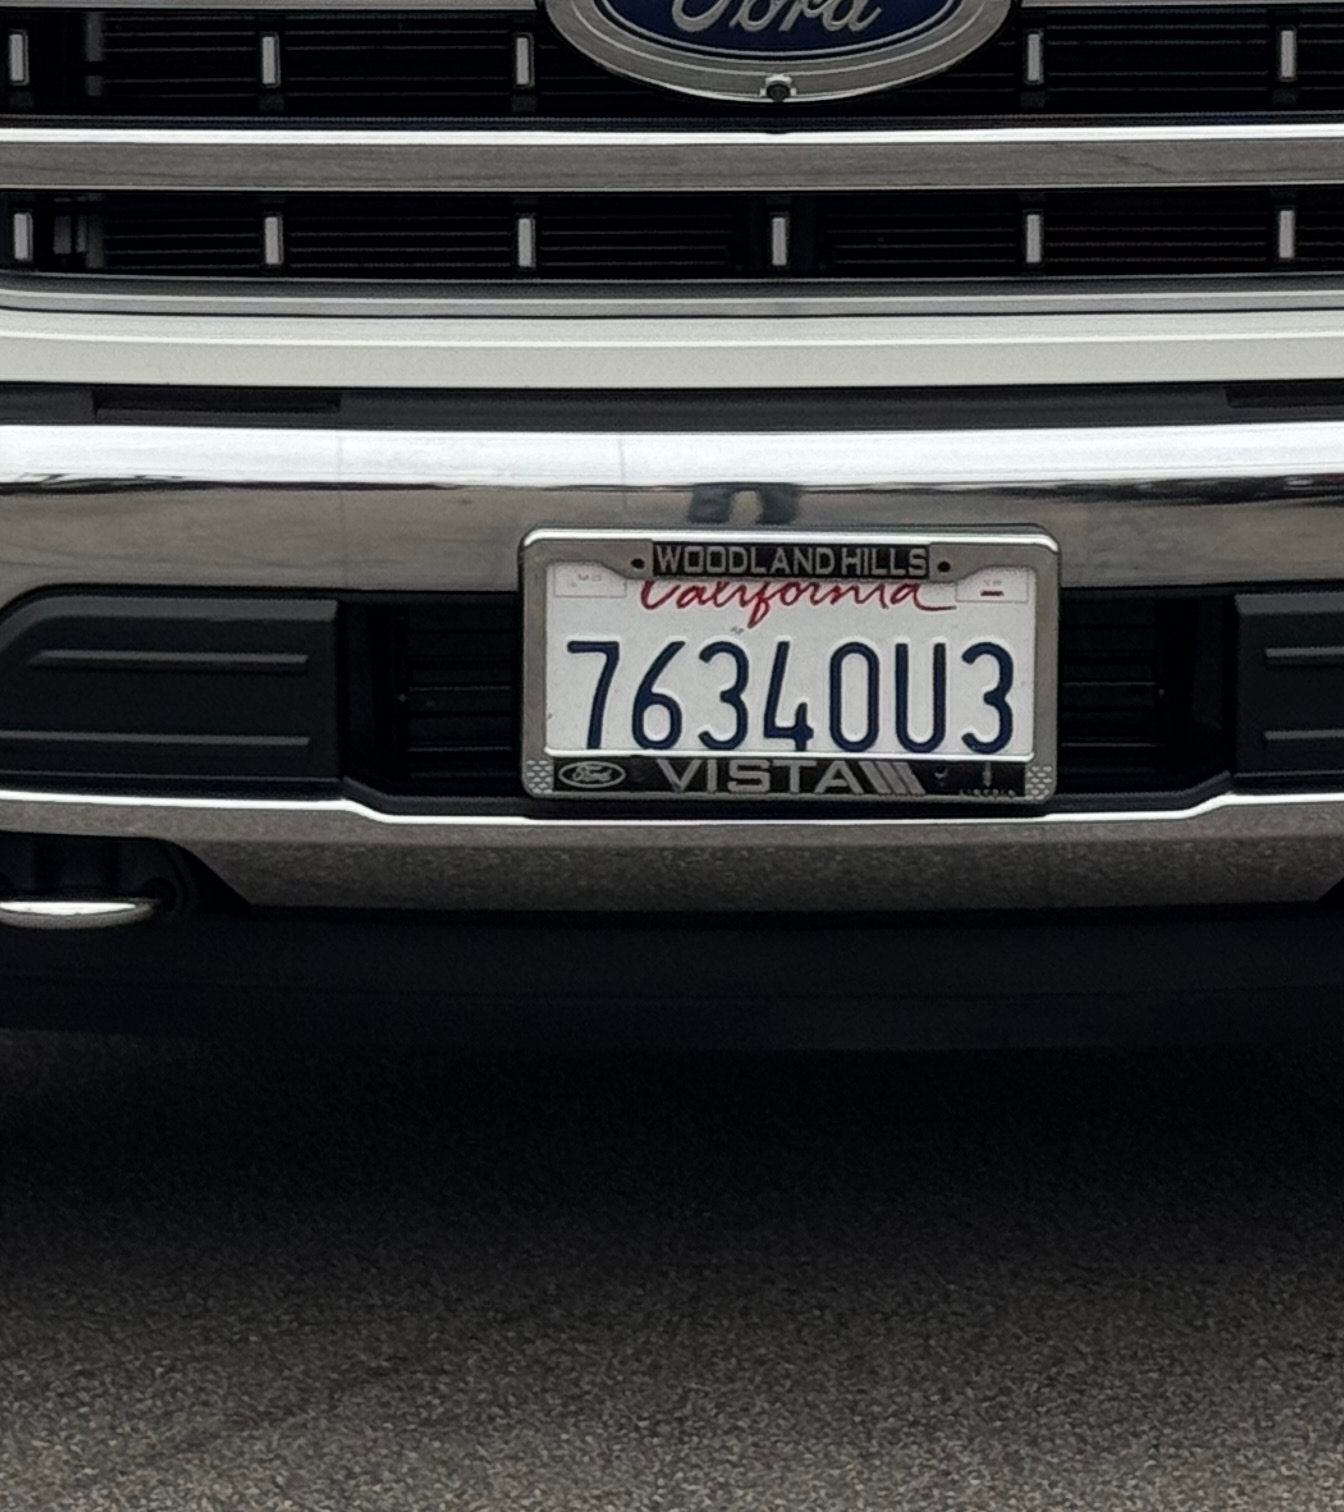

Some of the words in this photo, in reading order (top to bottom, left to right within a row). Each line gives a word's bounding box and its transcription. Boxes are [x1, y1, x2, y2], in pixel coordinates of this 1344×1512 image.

[656, 544, 836, 576] WOODLAND
[840, 546, 928, 577] HILLS
[640, 580, 957, 629] California
[567, 639, 1015, 754] 76340U3
[656, 759, 863, 793] VISTA
